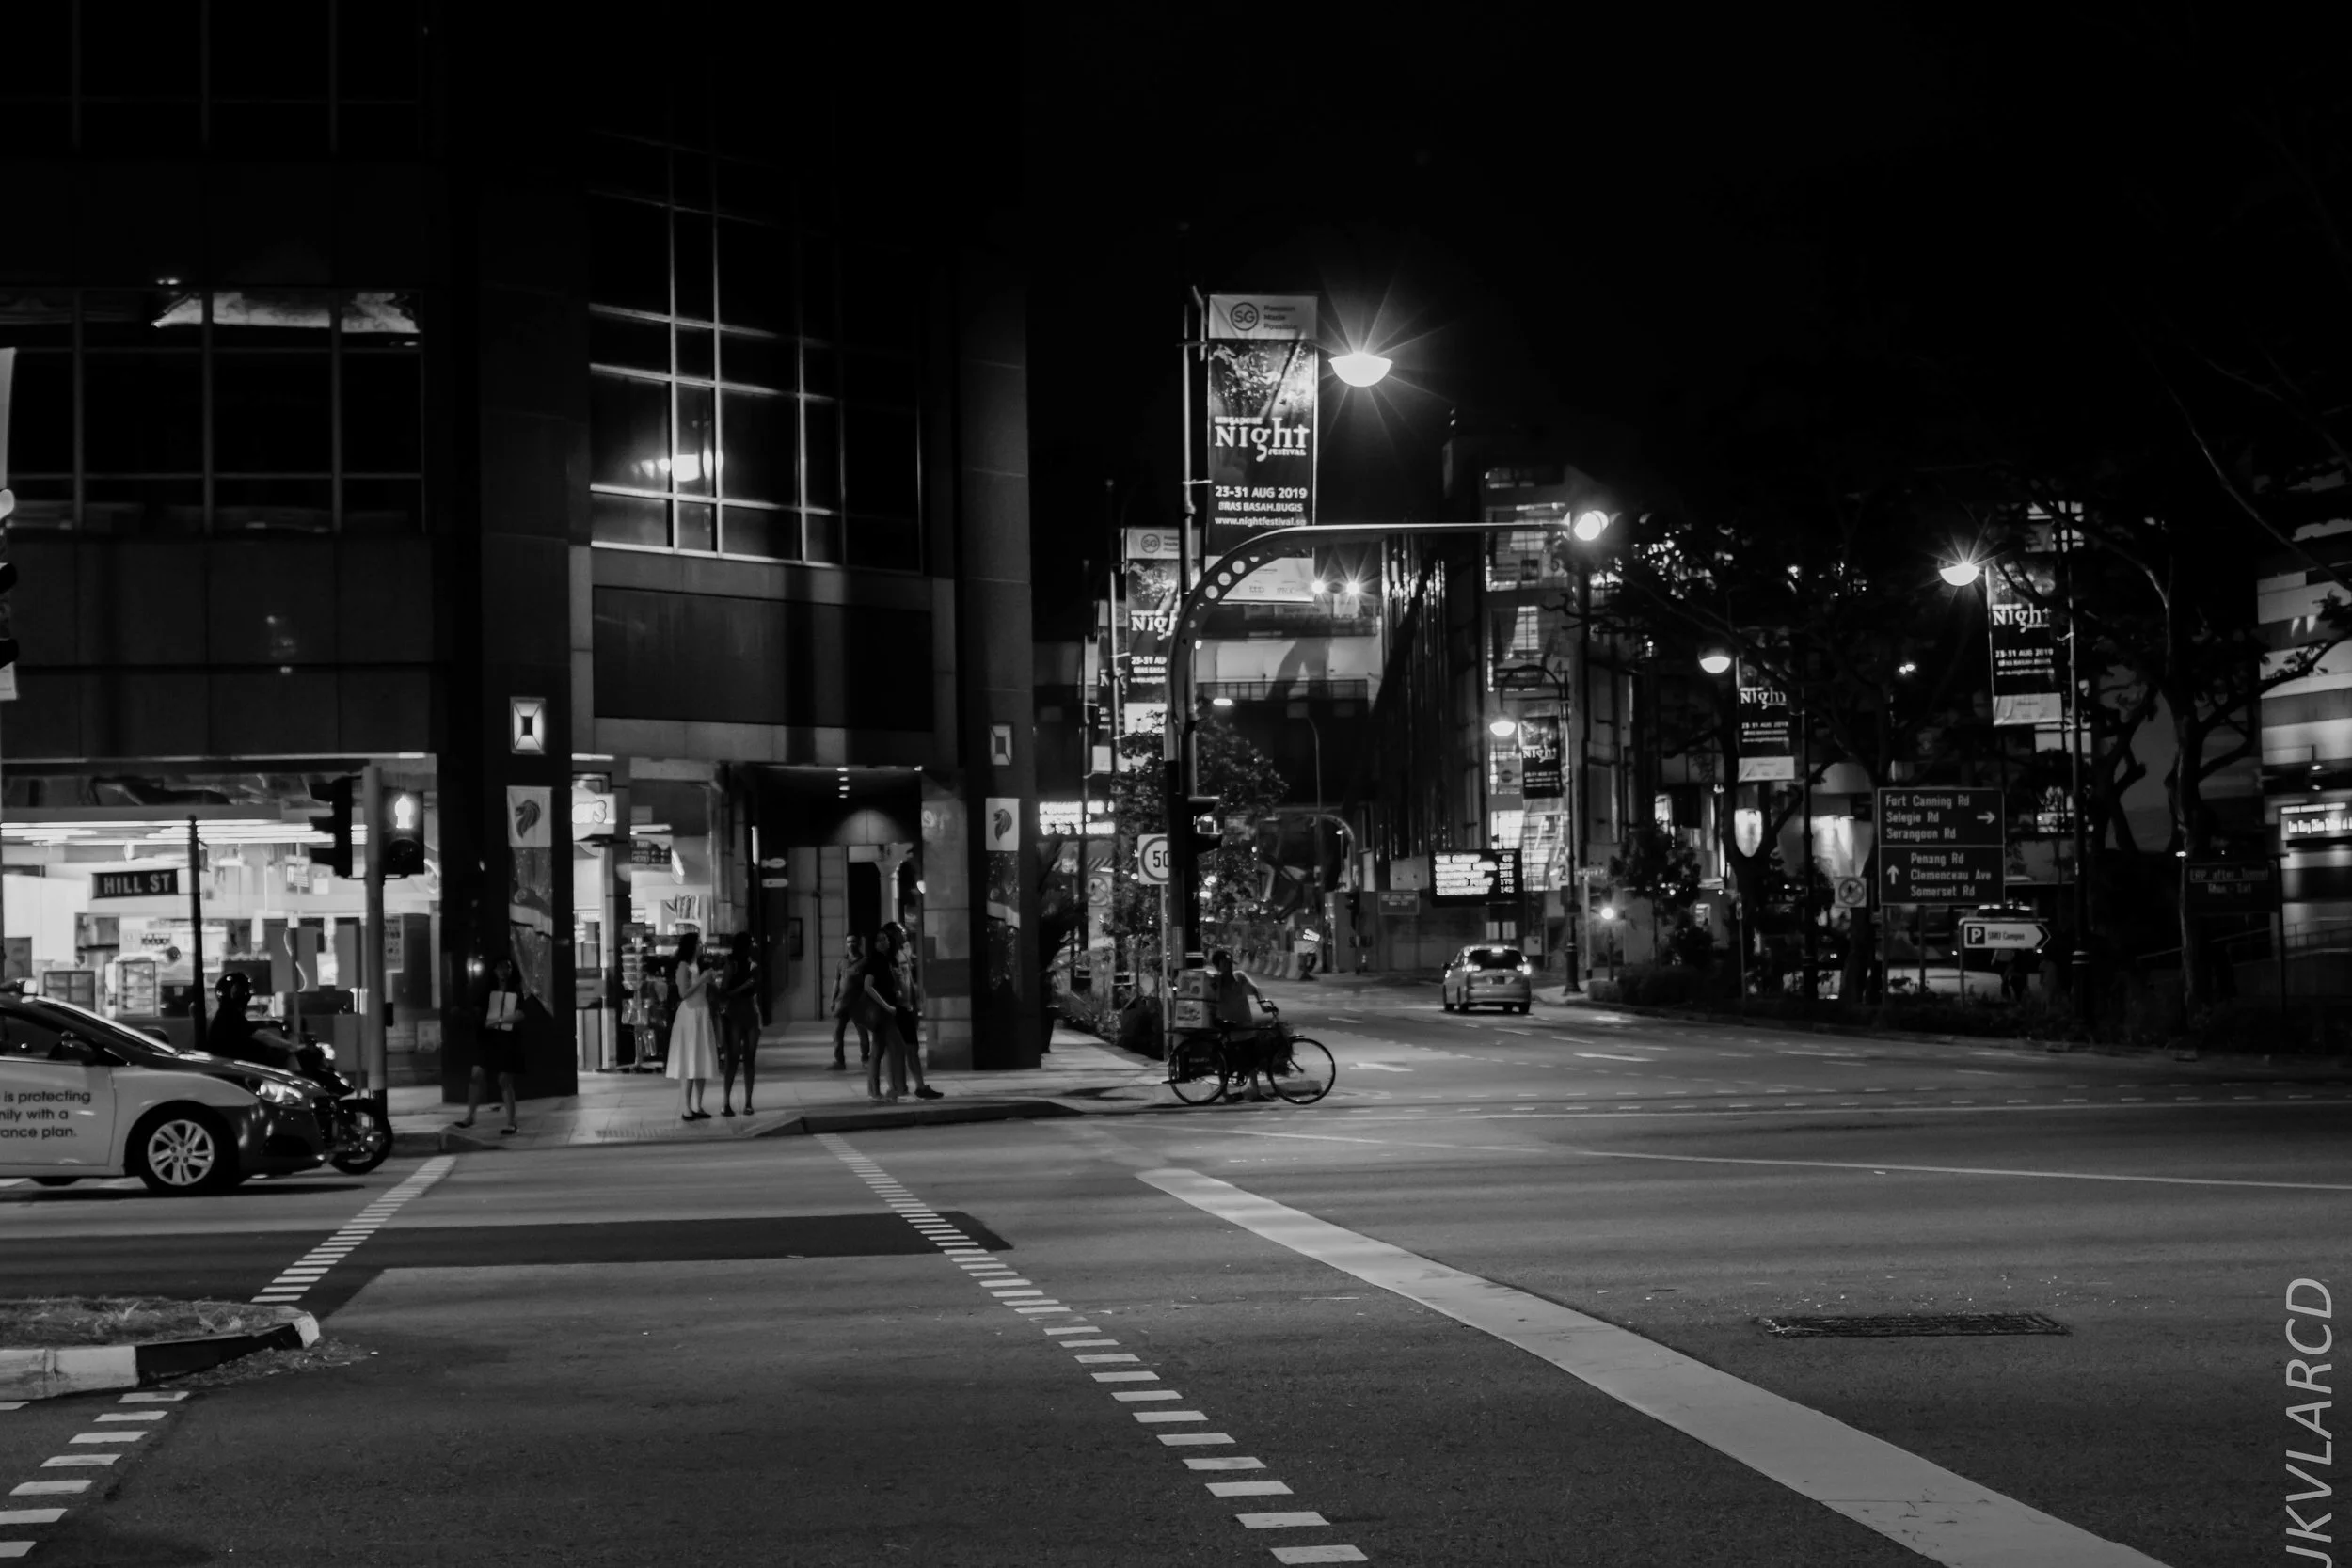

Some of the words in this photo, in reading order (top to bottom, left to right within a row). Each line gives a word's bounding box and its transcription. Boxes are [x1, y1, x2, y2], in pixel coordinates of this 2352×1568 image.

[1233, 309, 1255, 324] SG
[1215, 485, 1248, 498] 23-31
[1251, 487, 1275, 499] AUG
[1278, 487, 1308, 499] 2019
[1218, 501, 1242, 511] BRAS
[1154, 657, 1167, 665] AU
[1885, 794, 1907, 807] Fort
[1913, 794, 1953, 810] Canning
[1958, 794, 1970, 807] Rd
[1885, 810, 1921, 826] Selegie
[1927, 810, 1939, 823] Rd
[1886, 827, 1938, 842] Serangoon
[1944, 827, 1956, 840] Rd
[1910, 851, 1947, 867] Penang
[1951, 851, 1964, 864] Rd
[1910, 868, 1969, 881] Clemenceau
[1975, 868, 1992, 881] Ave
[103, 875, 143, 894] HILL
[150, 873, 170, 892] ST
[1910, 884, 1957, 897] Somerset
[1963, 884, 1975, 897] Rd
[1971, 927, 1982, 943] P
[4, 1091, 14, 1102] is
[18, 1090, 91, 1104] protecting
[26, 1107, 55, 1119] with
[58, 1110, 69, 1120] a
[41, 1125, 77, 1140] plan.
